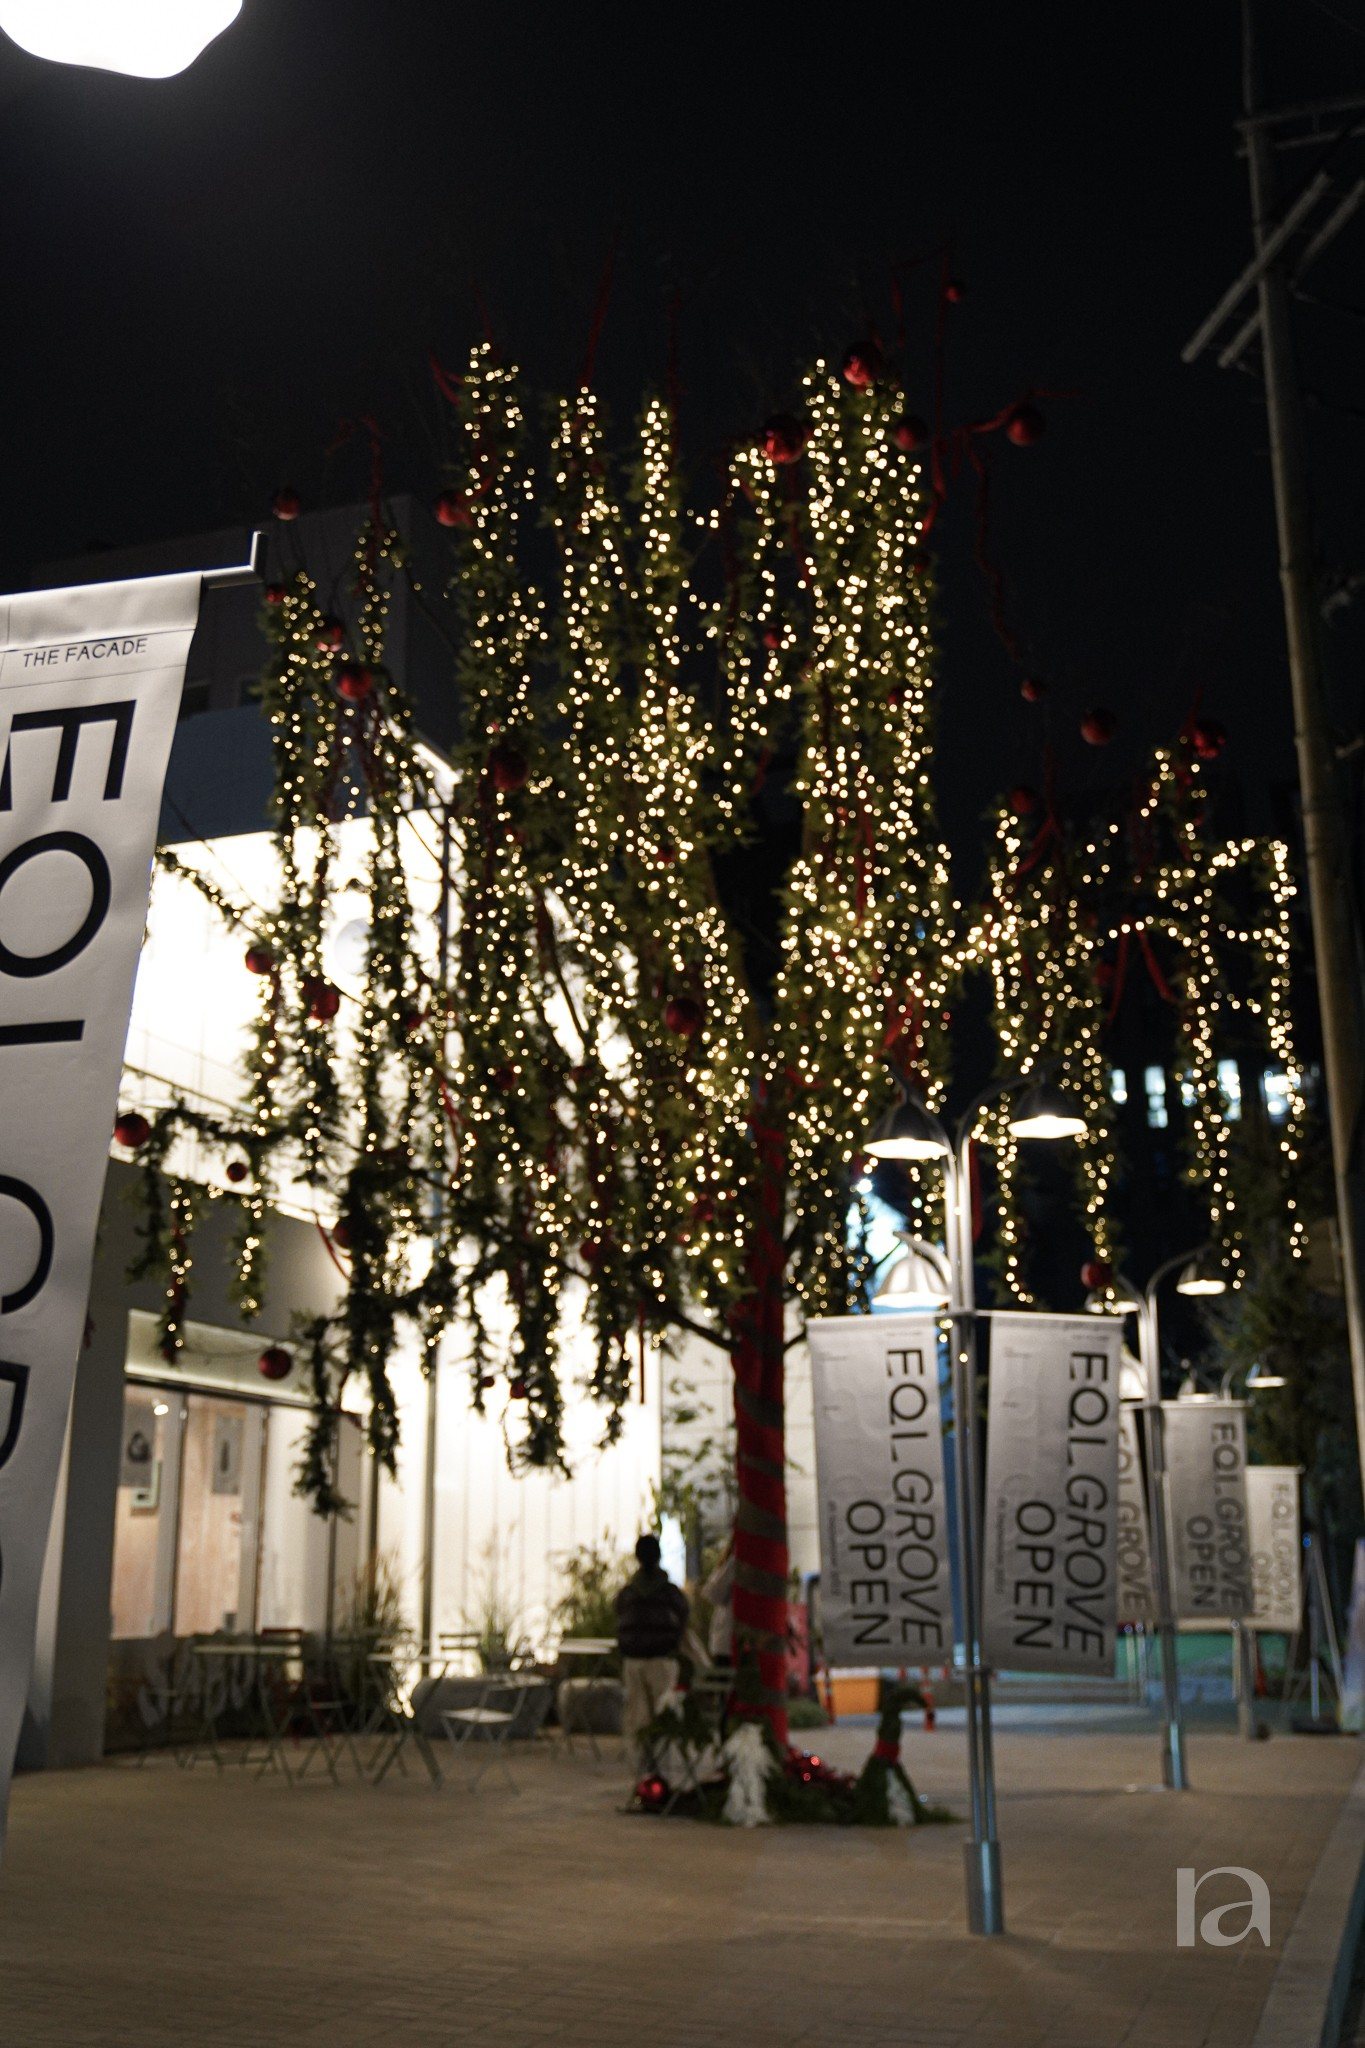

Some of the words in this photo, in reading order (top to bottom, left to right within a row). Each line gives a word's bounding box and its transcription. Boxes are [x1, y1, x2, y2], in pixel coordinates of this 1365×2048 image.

[23, 649, 60, 668] THE
[64, 637, 149, 663] FACADE
[846, 1500, 892, 1646] OPEN
[1013, 1501, 1056, 1649] OPEN
